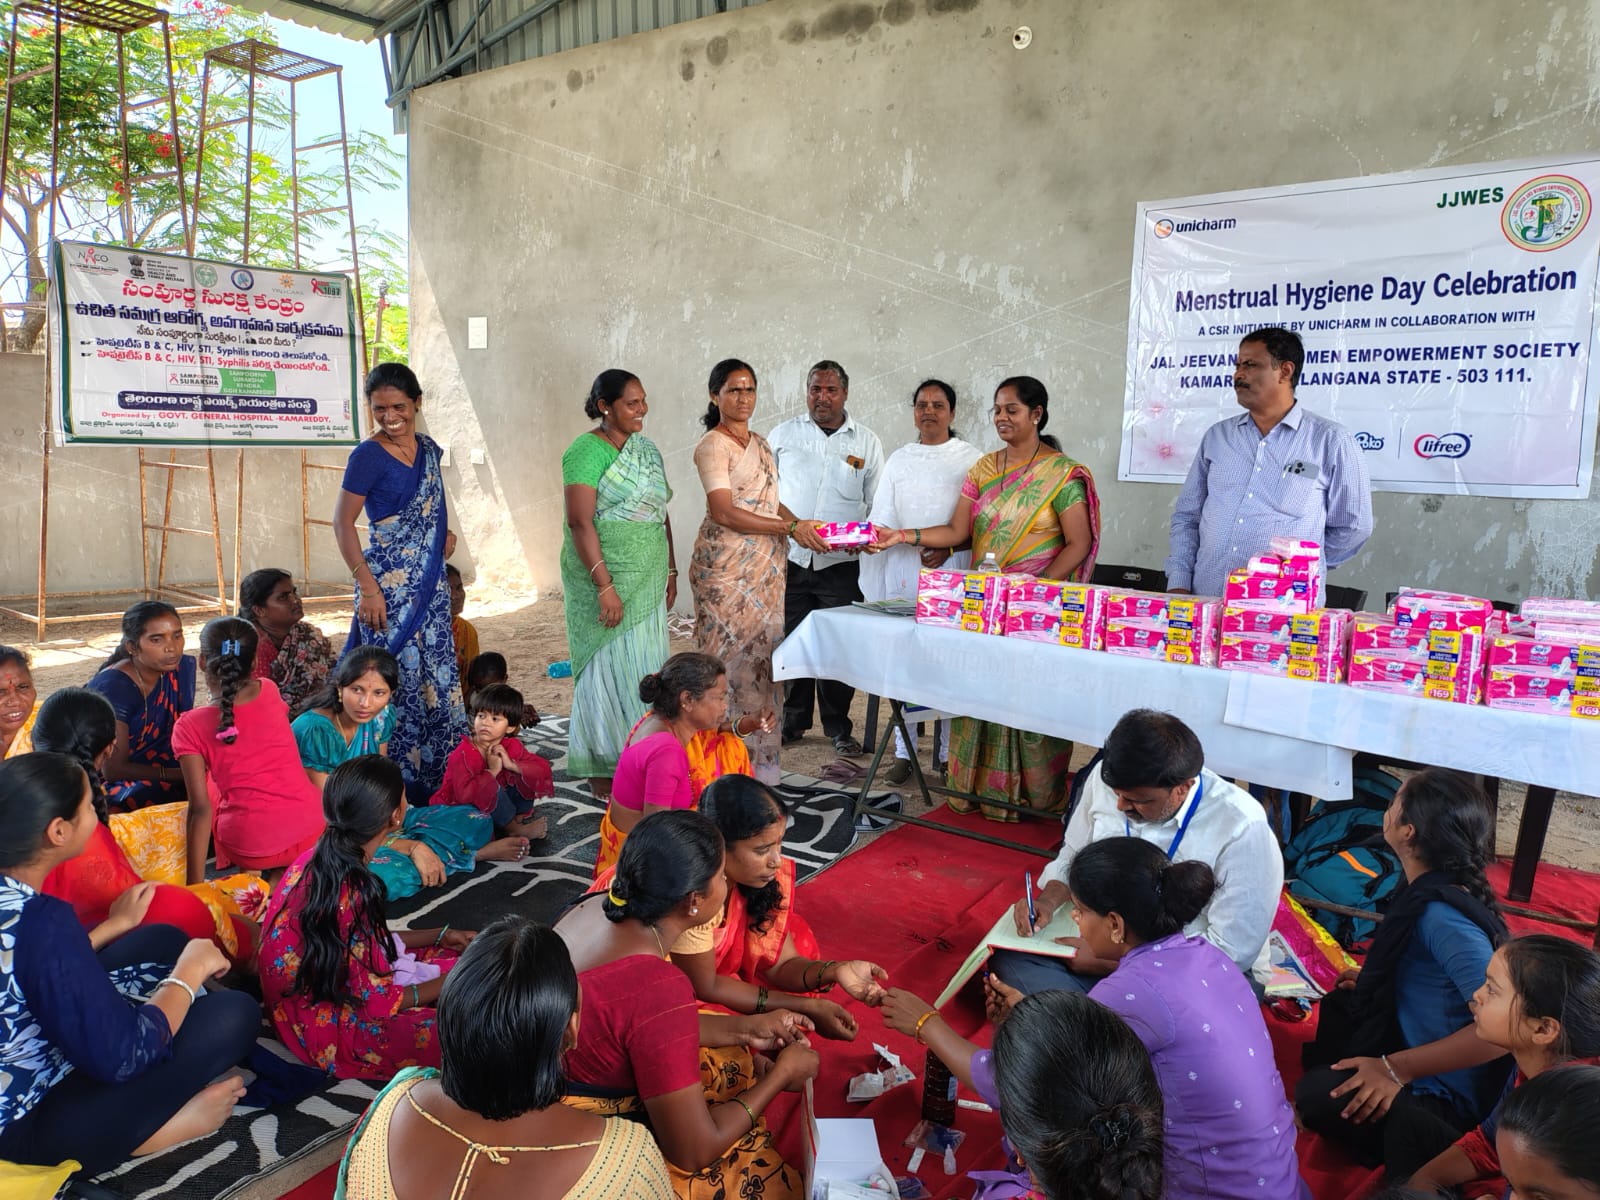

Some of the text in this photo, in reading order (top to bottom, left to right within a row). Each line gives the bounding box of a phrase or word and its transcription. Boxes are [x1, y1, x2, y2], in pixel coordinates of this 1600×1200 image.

[1436, 187, 1504, 208] JJWES
[1176, 218, 1236, 233] unicharm
[1175, 266, 1577, 312] Menstrual Hygiene Day Celebration
[1198, 326, 1205, 337] A
[1209, 325, 1229, 336] CSR
[1290, 321, 1305, 331] BY
[1308, 317, 1370, 331] UNICHARM
[1375, 317, 1387, 328] IN
[1391, 312, 1497, 327] COLLABORATION
[1501, 310, 1535, 323] WITH
[144, 341, 151, 349] B
[154, 341, 161, 350] &
[165, 342, 174, 351] C,
[177, 344, 195, 353] HIV,
[198, 345, 214, 354] STI,
[217, 346, 249, 357] Syphilis
[1150, 356, 1176, 369] JAL
[1306, 350, 1341, 364] MEN
[1347, 345, 1487, 362] EMPOWERMENT
[1492, 342, 1581, 359] SOCIETY
[144, 353, 151, 361] B
[154, 353, 162, 362] &
[165, 354, 174, 363] C,
[178, 355, 196, 364] HIV,
[200, 356, 214, 365] STI,
[217, 358, 249, 368] Syphilis
[1301, 371, 1381, 386] LANGANA
[1387, 370, 1441, 385] STATE
[1457, 369, 1488, 384] 503
[1495, 367, 1532, 383] 111.
[191, 413, 231, 421] GENERAL
[1423, 440, 1462, 453] lifree
